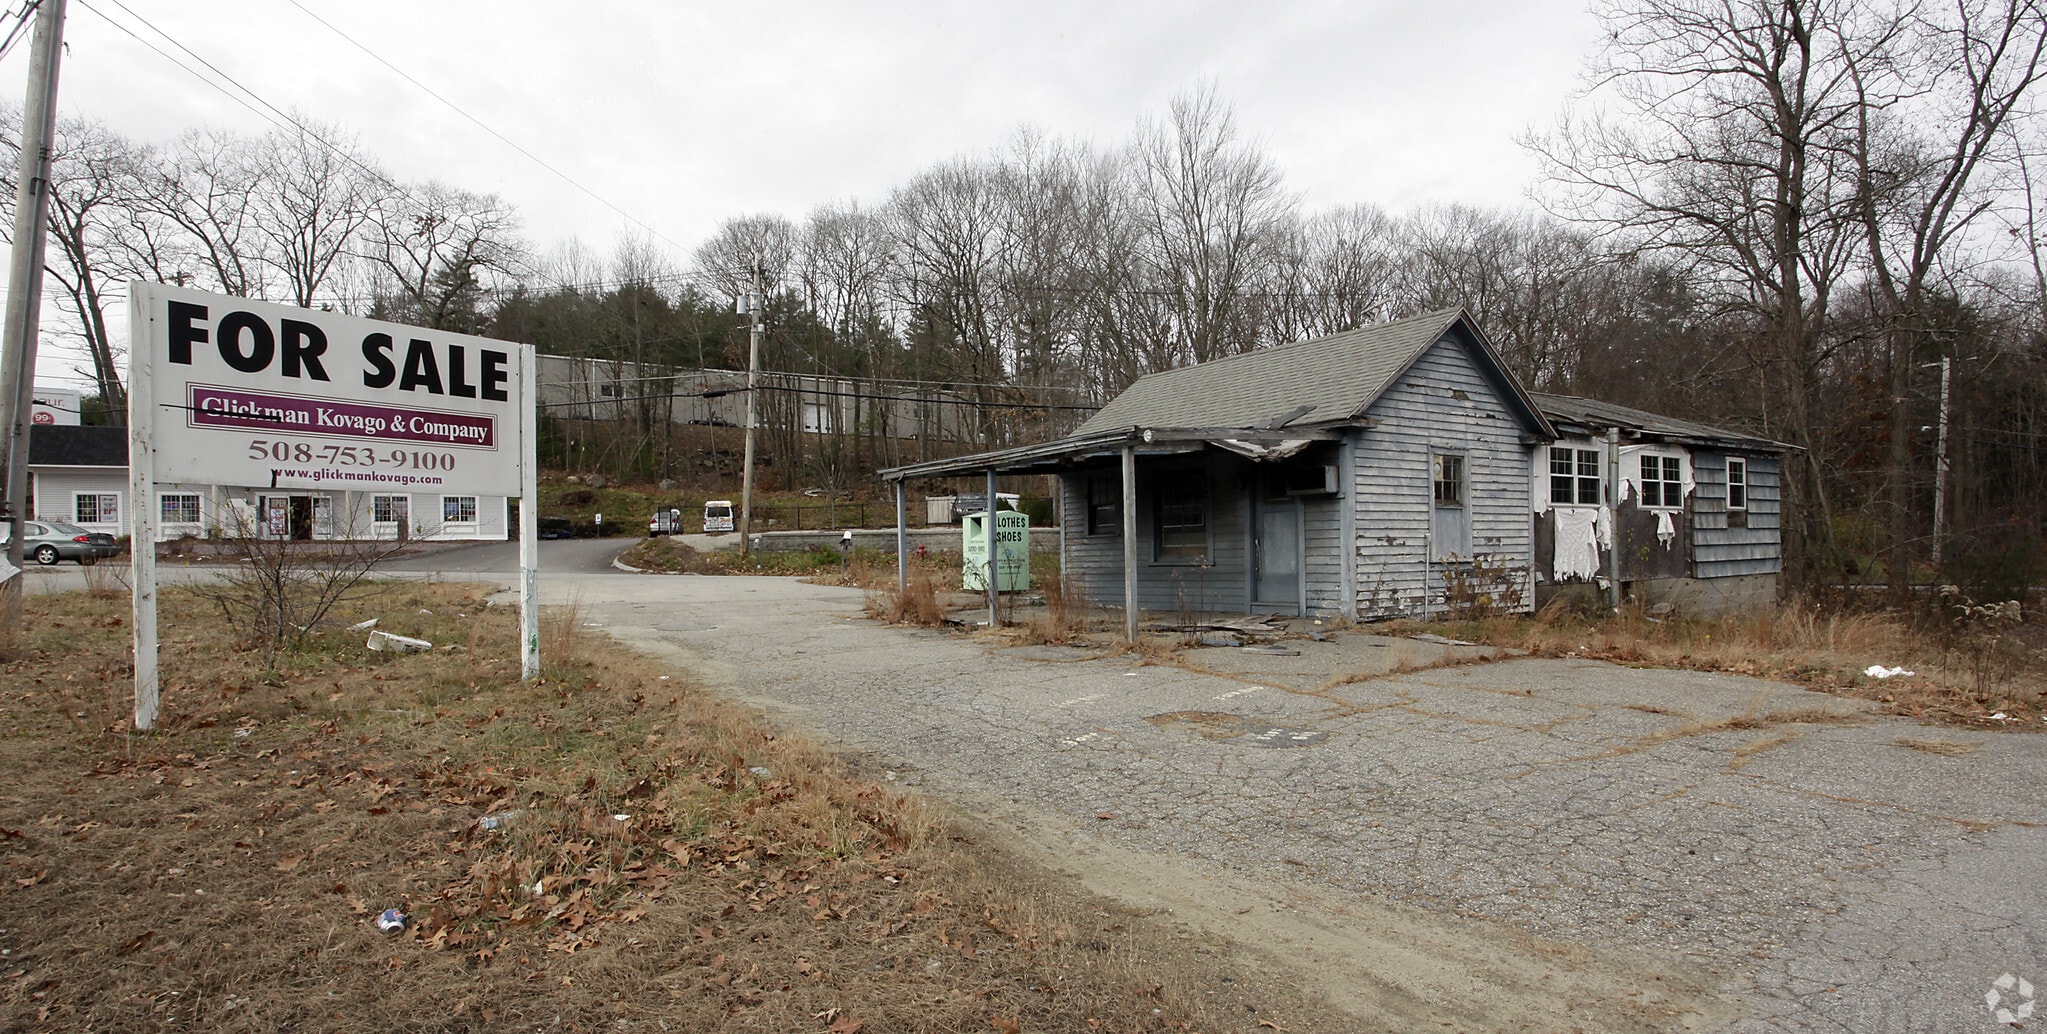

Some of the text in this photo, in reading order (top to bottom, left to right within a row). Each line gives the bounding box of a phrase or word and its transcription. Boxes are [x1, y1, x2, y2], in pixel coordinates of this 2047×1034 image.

[168, 300, 508, 402] FOR SALE
[201, 397, 488, 443] Glickman Kovago & Company
[248, 440, 456, 472] 508-753-9100
[271, 468, 443, 485] www.glickmankovago.com
[997, 516, 1026, 528] LOTHES
[996, 531, 1022, 542] SHOES
